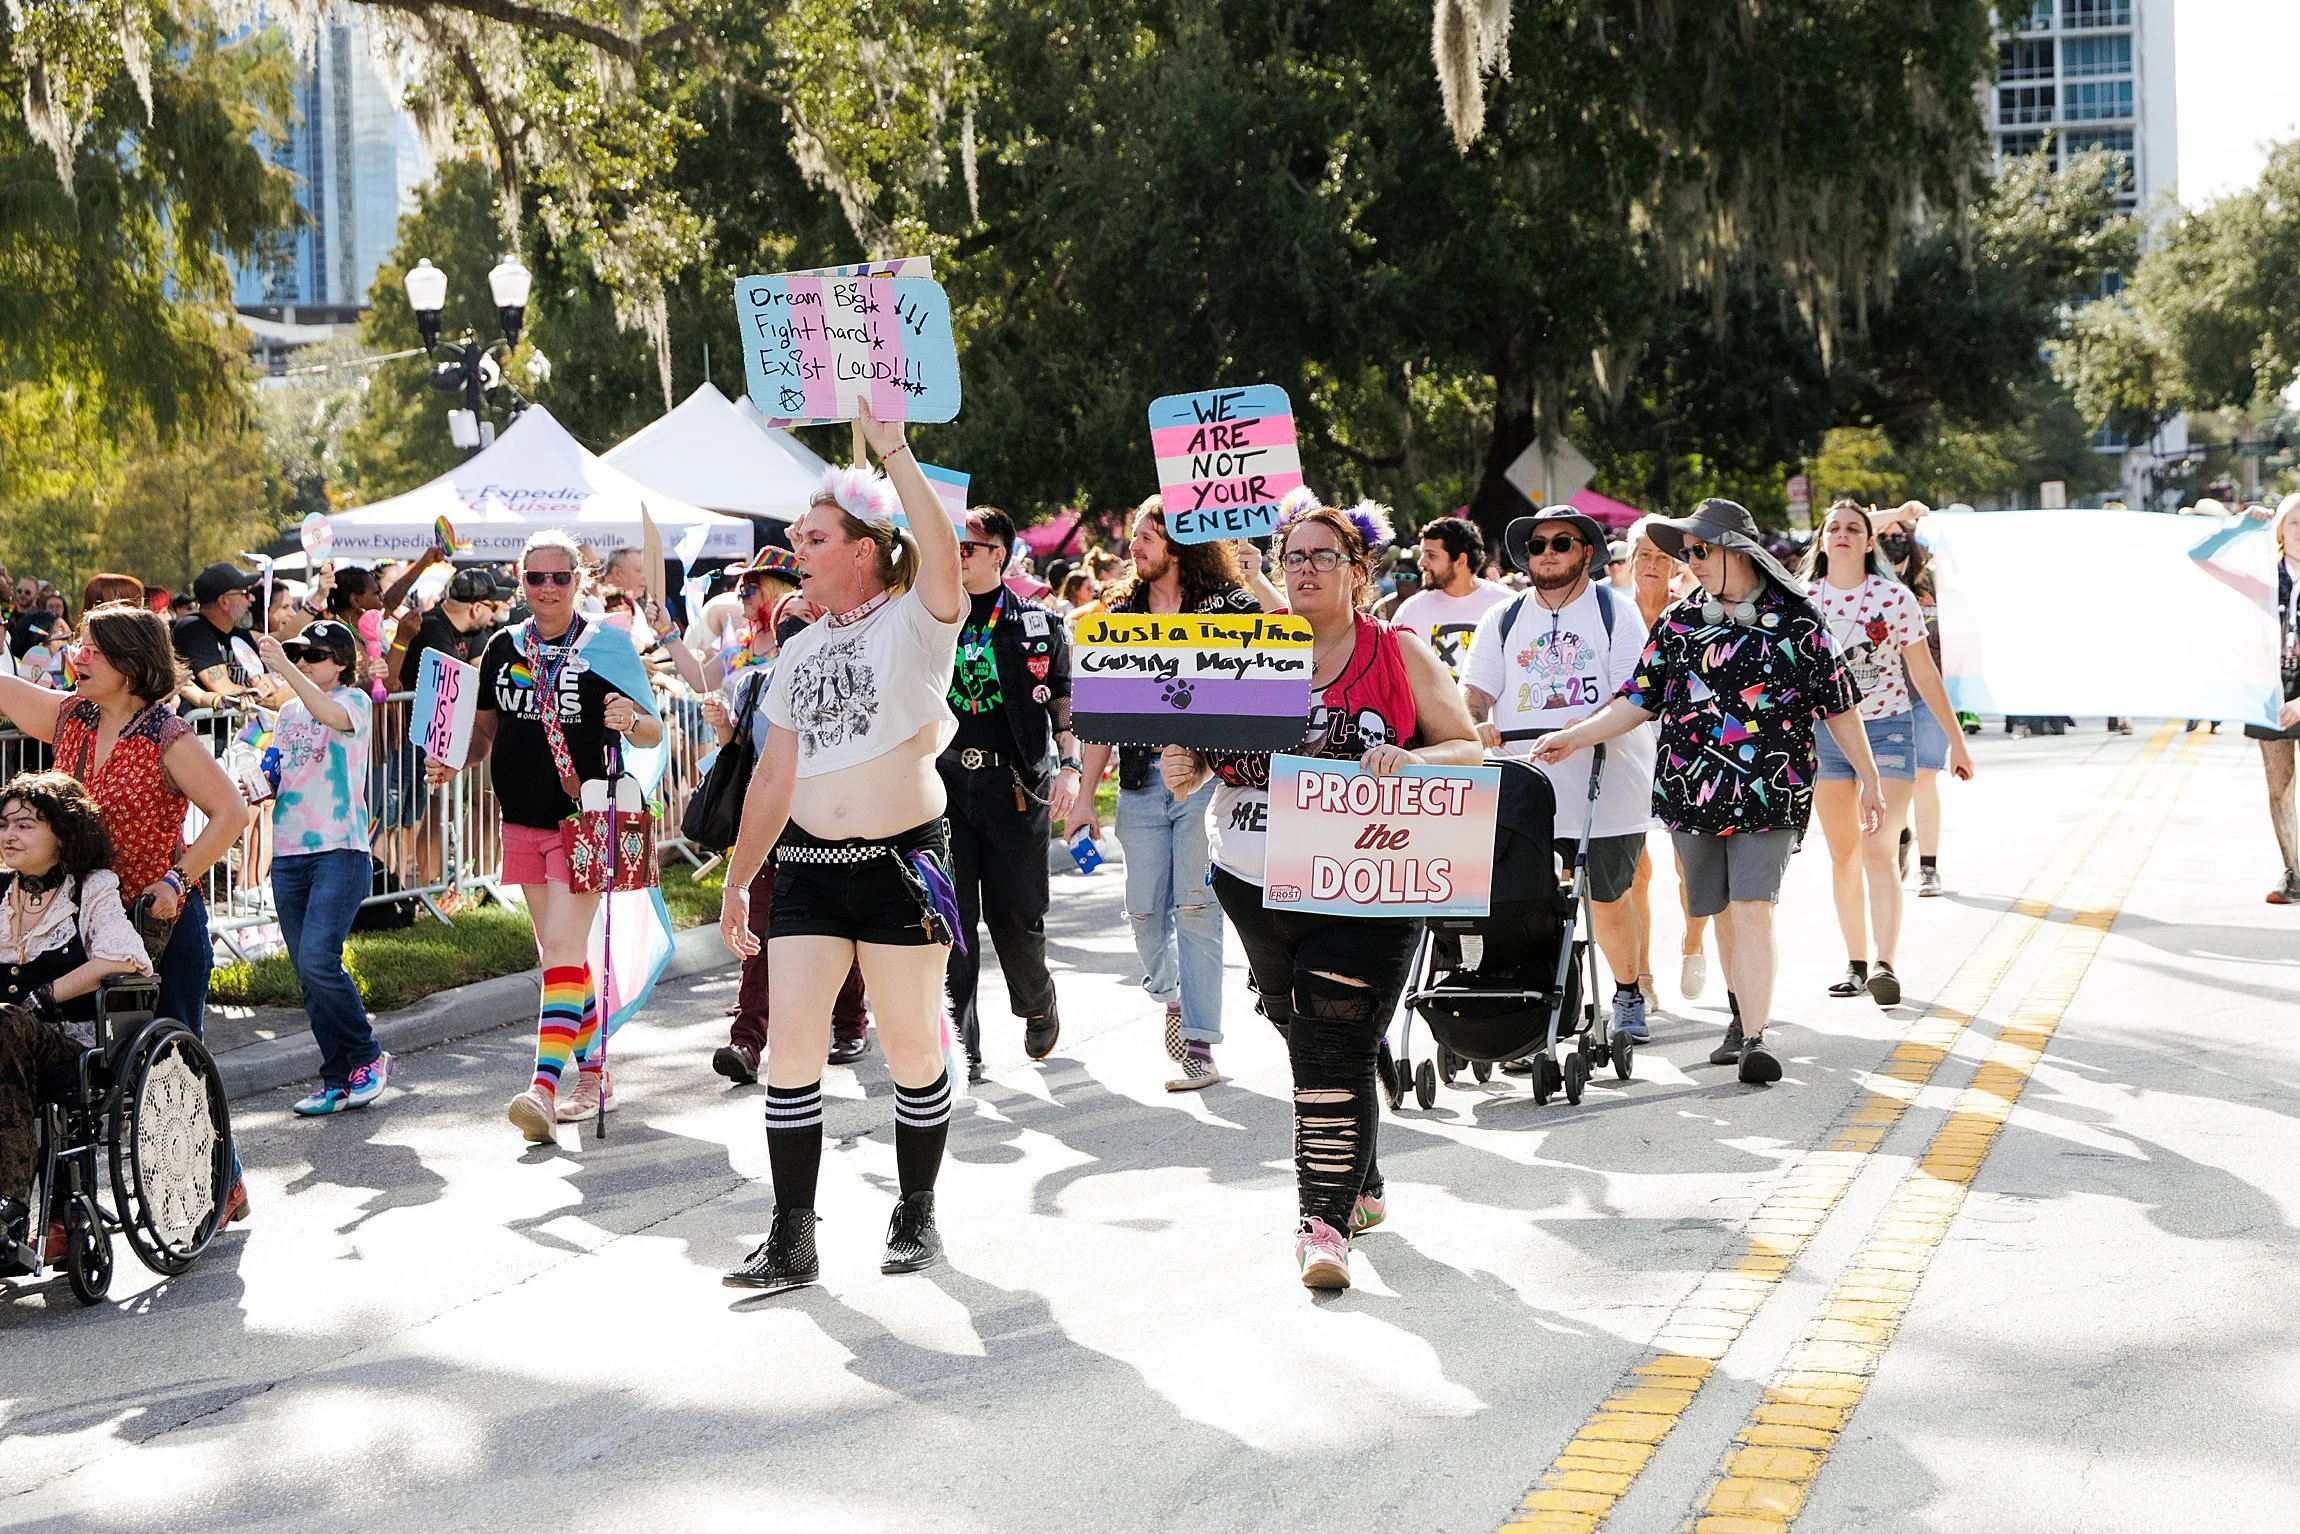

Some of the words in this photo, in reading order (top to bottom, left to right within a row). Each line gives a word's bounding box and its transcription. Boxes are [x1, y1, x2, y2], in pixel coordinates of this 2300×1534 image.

[749, 287, 822, 307] Dream
[833, 282, 880, 314] Big!
[755, 313, 817, 349] Fight
[821, 314, 884, 350] hard!
[760, 349, 826, 380] Exist
[1187, 418, 1260, 454] ARE
[1191, 449, 1268, 480] NOT
[469, 498, 581, 511] Cuises
[1191, 475, 1276, 511] YOUR
[1175, 505, 1279, 533] ENEM
[432, 659, 460, 704] THIS
[1080, 651, 1180, 684] Causing
[434, 696, 447, 729] IS
[424, 721, 452, 759] ME!
[1296, 769, 1473, 816] PROTECT
[1354, 823, 1410, 851] the
[1270, 891, 1300, 899] FROST
[1311, 855, 1453, 904] DOLLS
